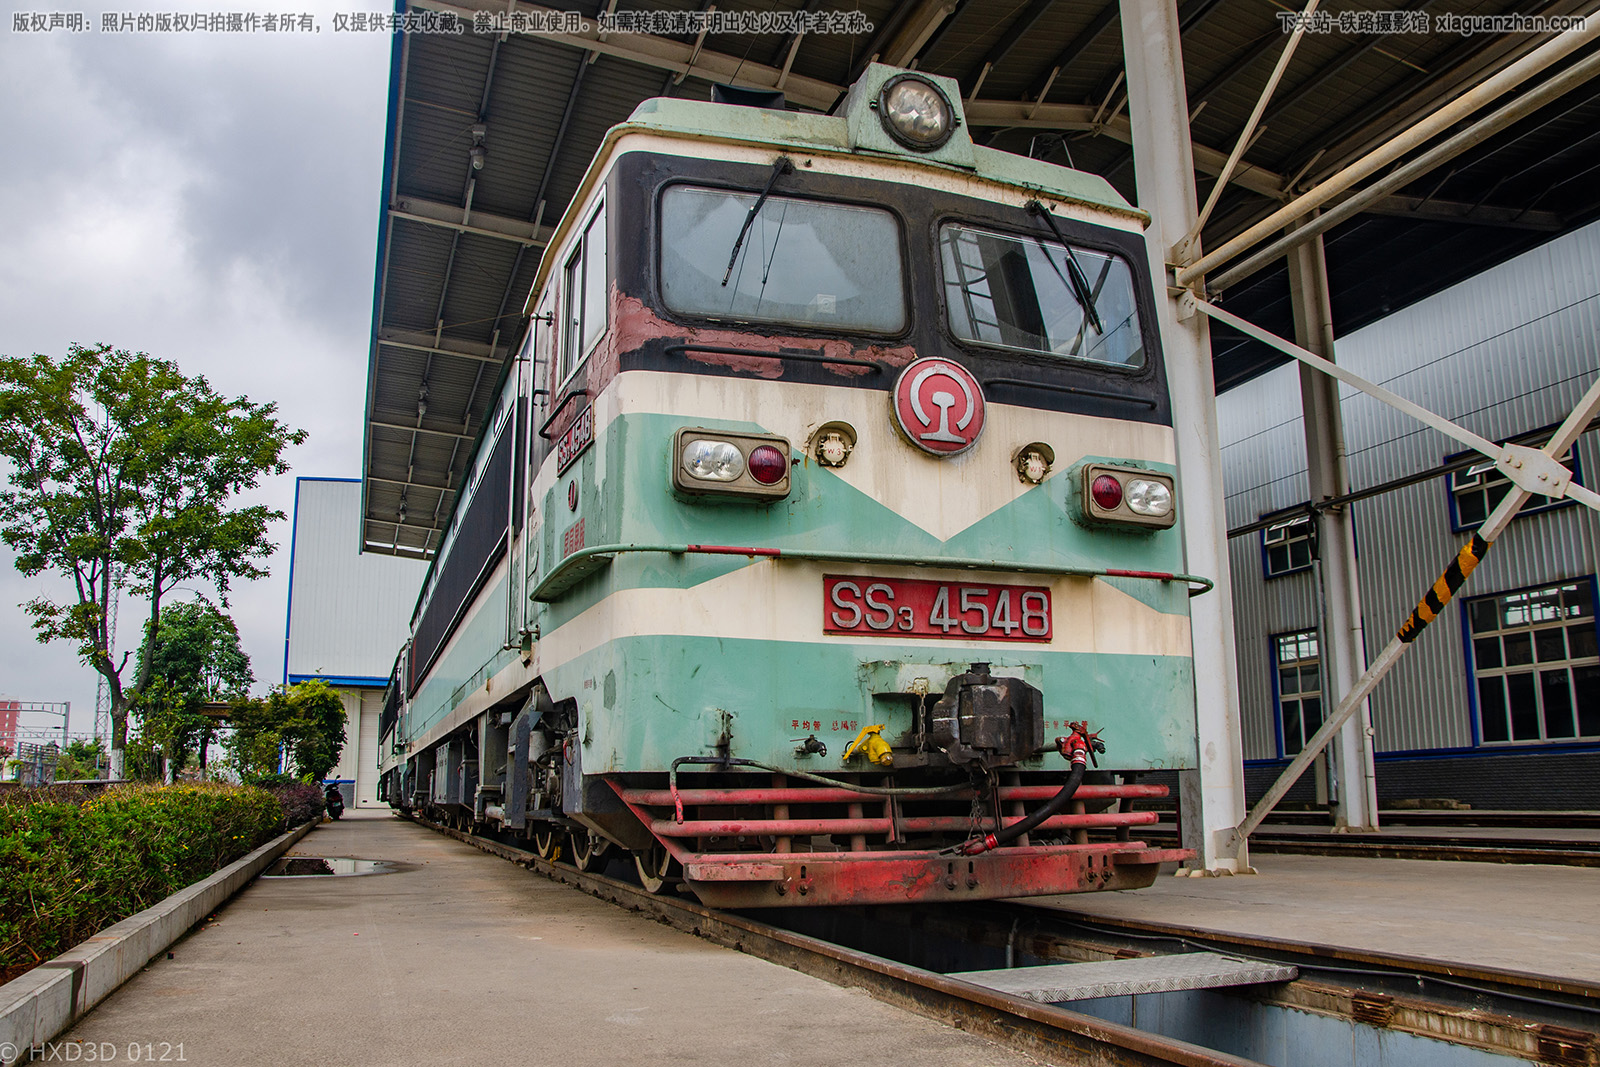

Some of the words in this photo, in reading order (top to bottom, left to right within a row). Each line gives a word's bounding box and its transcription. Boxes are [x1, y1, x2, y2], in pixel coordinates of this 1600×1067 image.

[831, 581, 914, 631] SS3
[930, 586, 1049, 636] 4548
[791, 719, 822, 731] 平均管
[831, 720, 858, 731] 总风管
